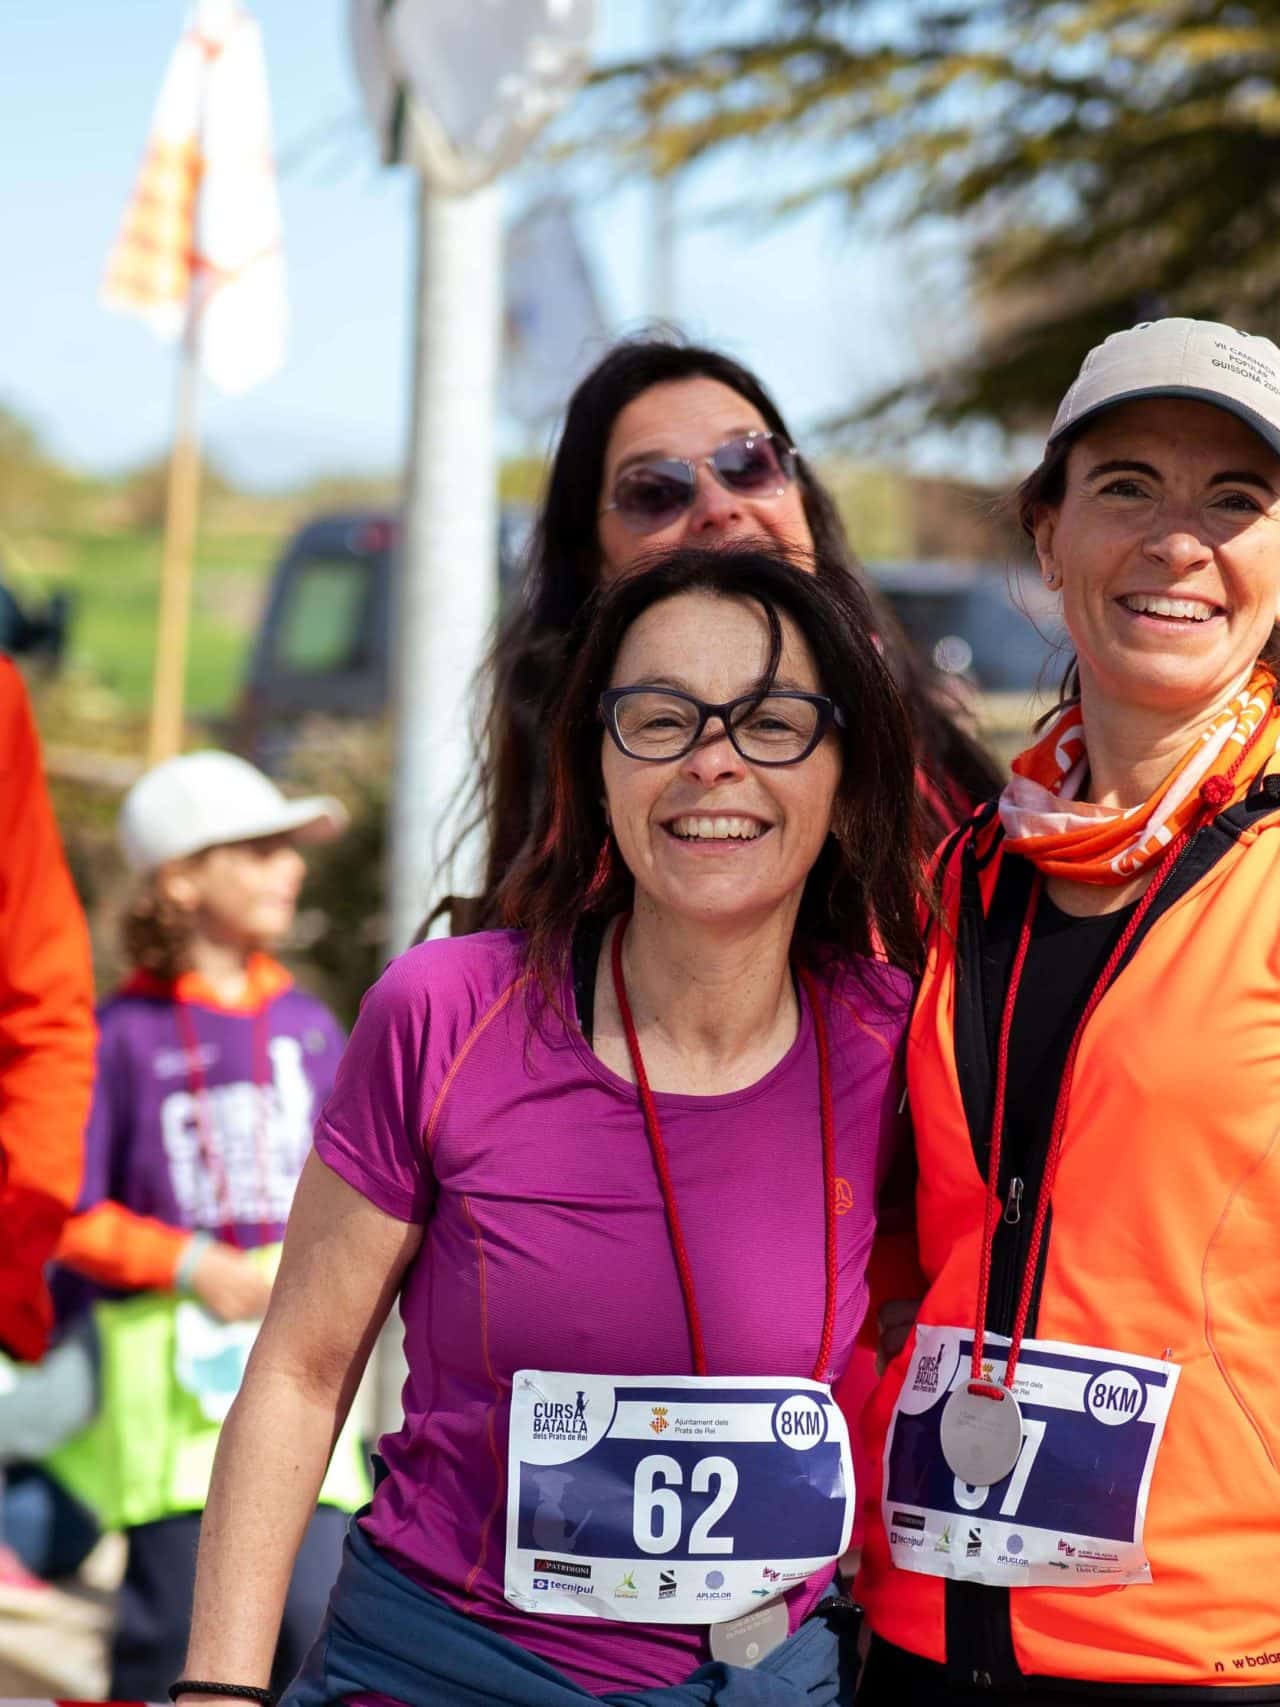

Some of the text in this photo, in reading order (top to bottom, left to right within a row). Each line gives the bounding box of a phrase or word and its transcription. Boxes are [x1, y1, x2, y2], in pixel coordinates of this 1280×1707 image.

[1212, 359, 1261, 384] GUISSONA
[1092, 1382, 1138, 1413] 8KM
[534, 1402, 585, 1420] CURSA
[533, 1418, 588, 1433] BATALLA
[675, 1418, 729, 1426] Ajuntament dels
[781, 1411, 820, 1436] 8KM
[633, 1454, 739, 1555] 62
[546, 1562, 590, 1574] PATRIMONI
[551, 1580, 594, 1594] tecnipul
[1214, 1657, 1244, 1672] nw
